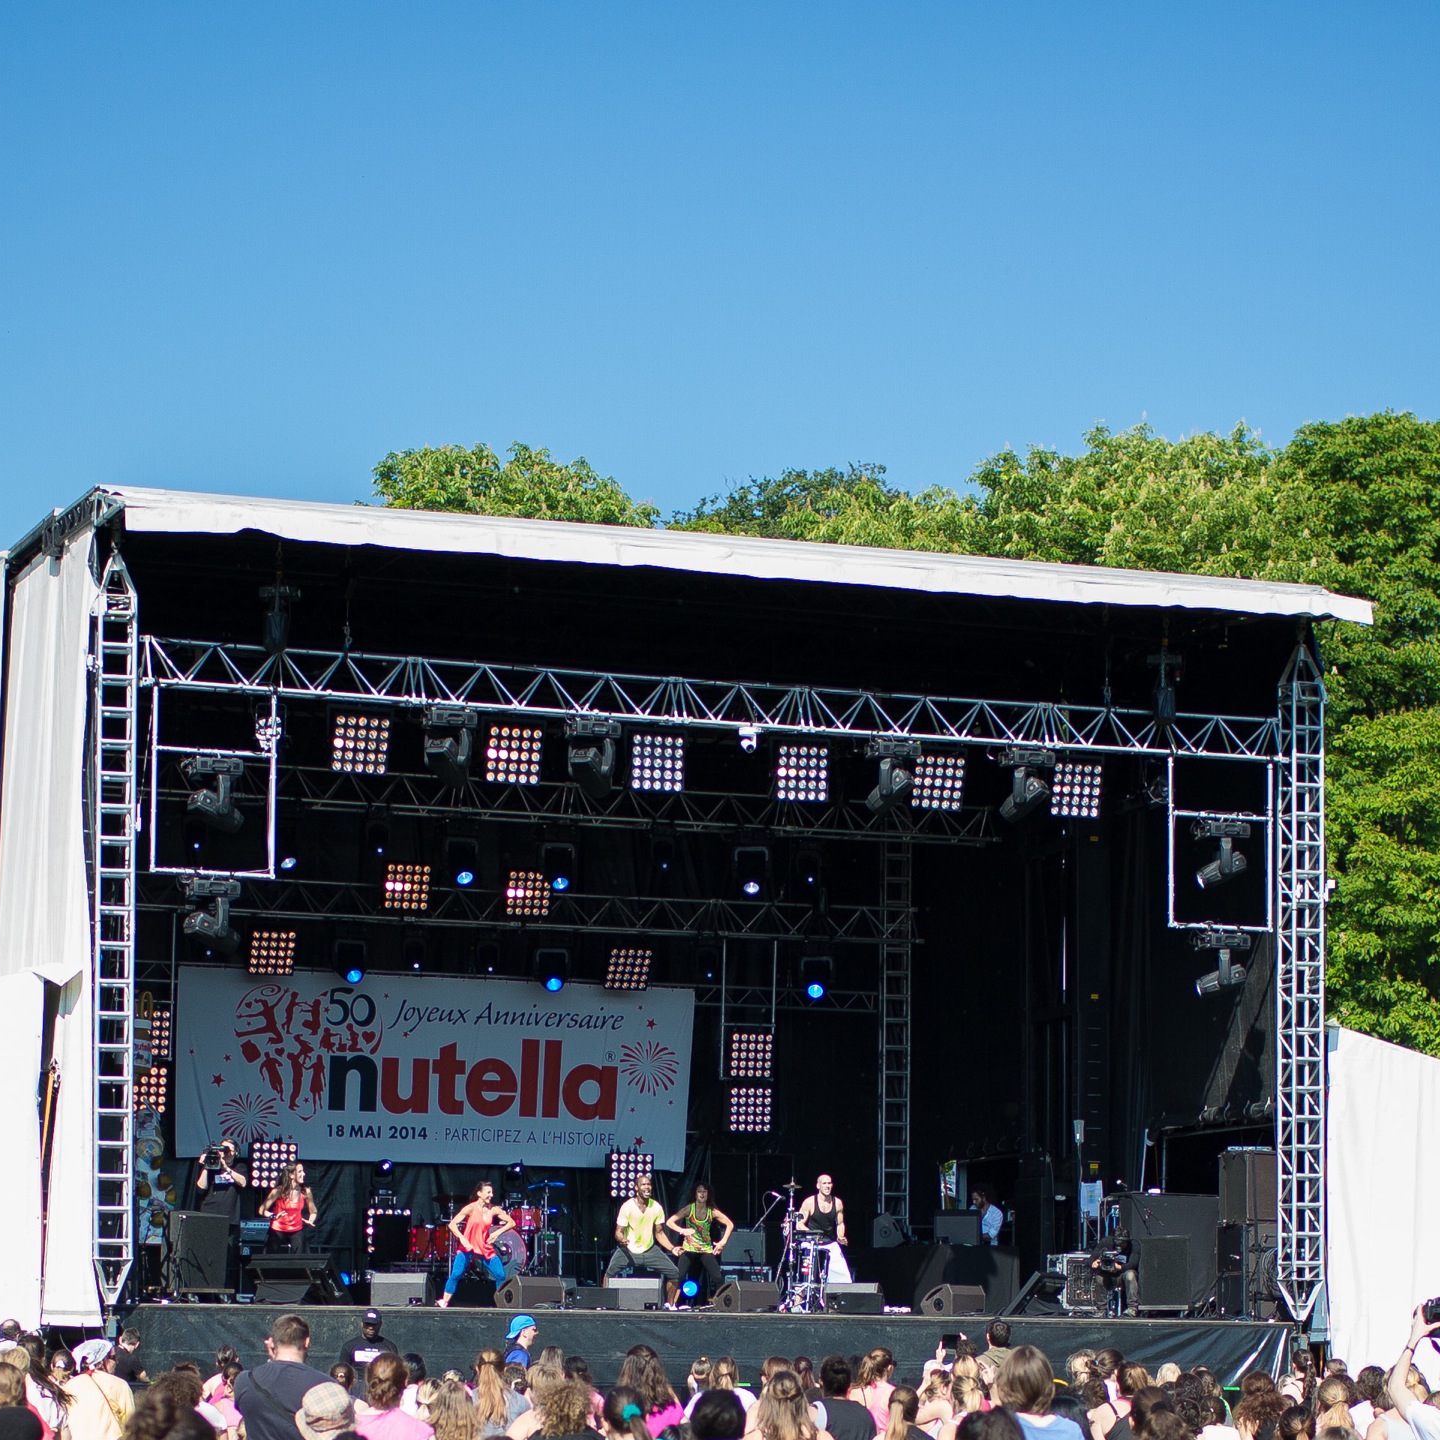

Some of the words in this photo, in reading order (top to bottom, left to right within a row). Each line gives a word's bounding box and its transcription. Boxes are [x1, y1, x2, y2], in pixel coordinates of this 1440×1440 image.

[325, 986, 377, 1028] 50
[387, 999, 470, 1033] Joyeux
[474, 1001, 625, 1031] Anniversaire
[327, 1038, 619, 1121] nutella
[327, 1124, 345, 1138] 18
[349, 1125, 382, 1140] MAI
[388, 1126, 428, 1141] 2014
[444, 1128, 522, 1144] PARTICIPEZ
[526, 1130, 538, 1145] A
[542, 1130, 615, 1147] L'HISTOIRE
